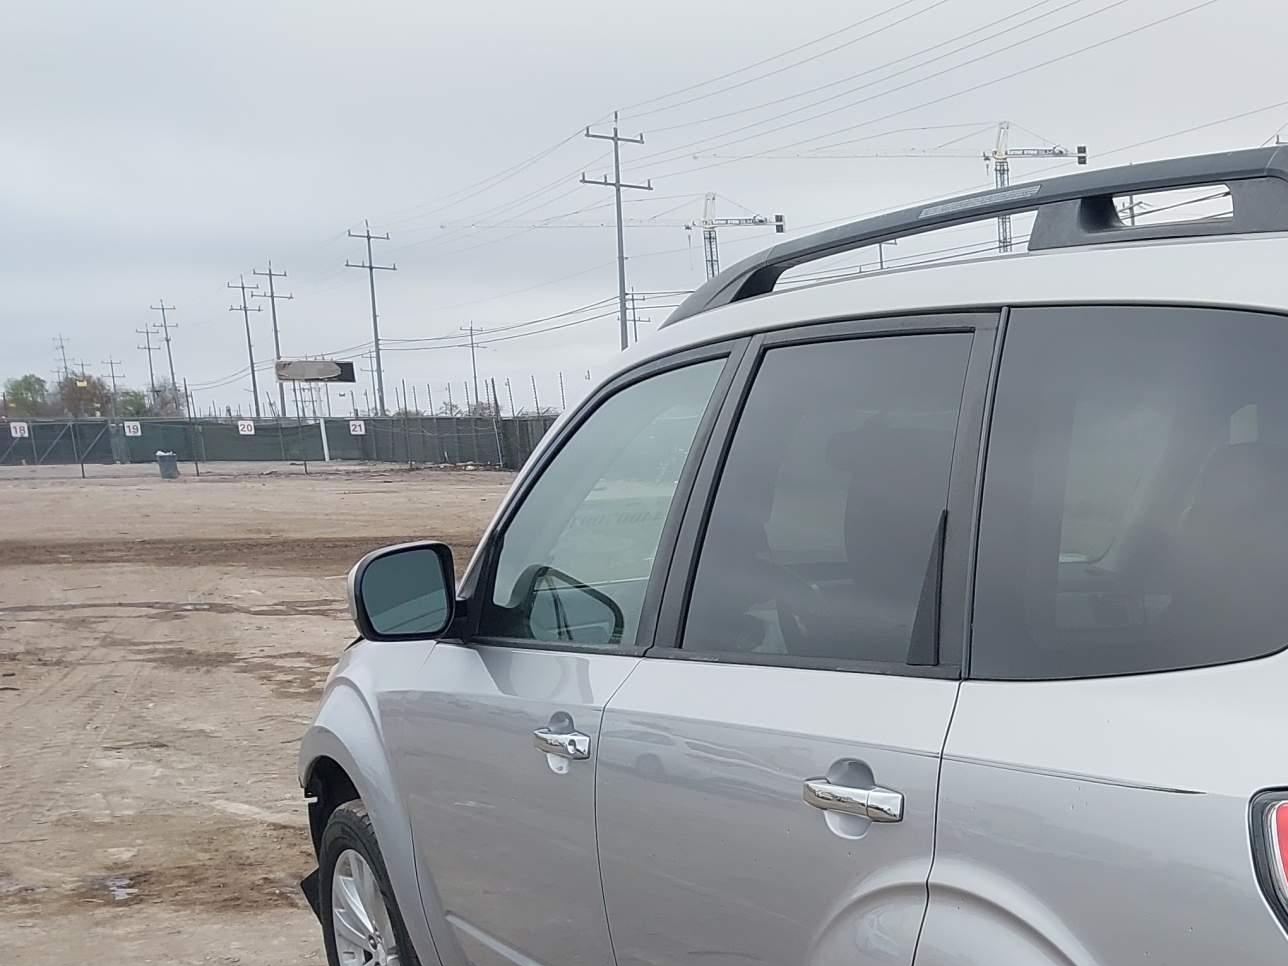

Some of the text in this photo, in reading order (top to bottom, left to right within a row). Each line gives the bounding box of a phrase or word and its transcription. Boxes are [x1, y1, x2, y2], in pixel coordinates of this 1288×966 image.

[12, 425, 26, 436] 18
[125, 424, 140, 435] 19
[239, 423, 253, 433] 20
[351, 423, 363, 433] 21
